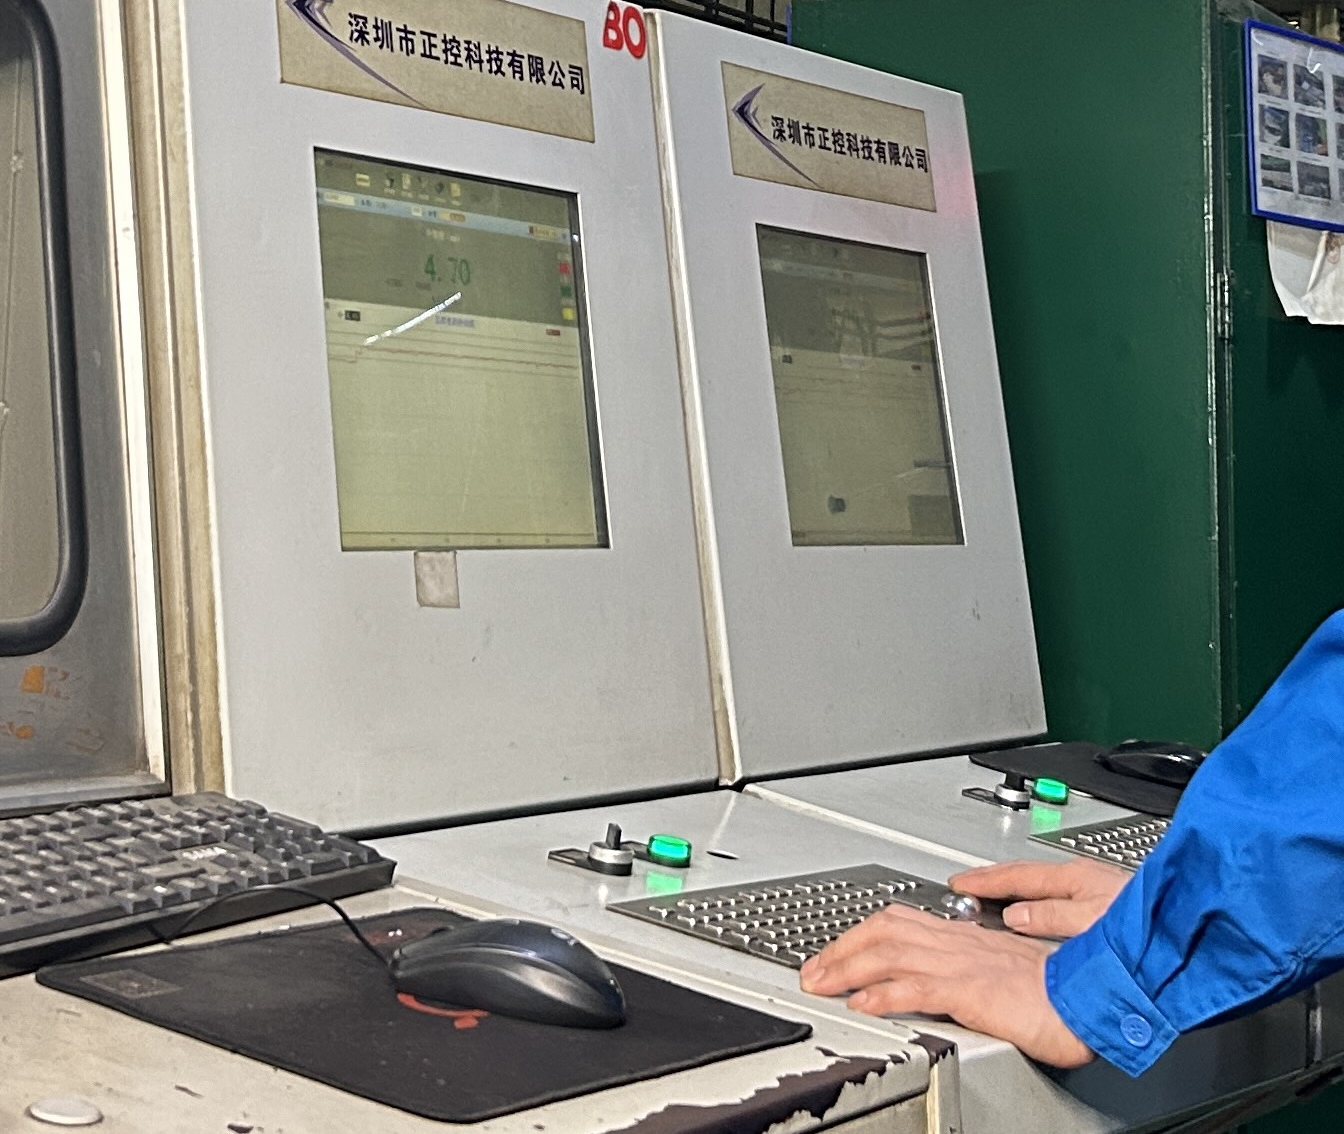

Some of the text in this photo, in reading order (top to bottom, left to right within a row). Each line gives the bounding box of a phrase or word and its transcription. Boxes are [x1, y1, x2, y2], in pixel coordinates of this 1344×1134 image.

[347, 11, 586, 95] 深圳市正控科技有限公司
[770, 114, 929, 174] 深圳市正控科技有限公司
